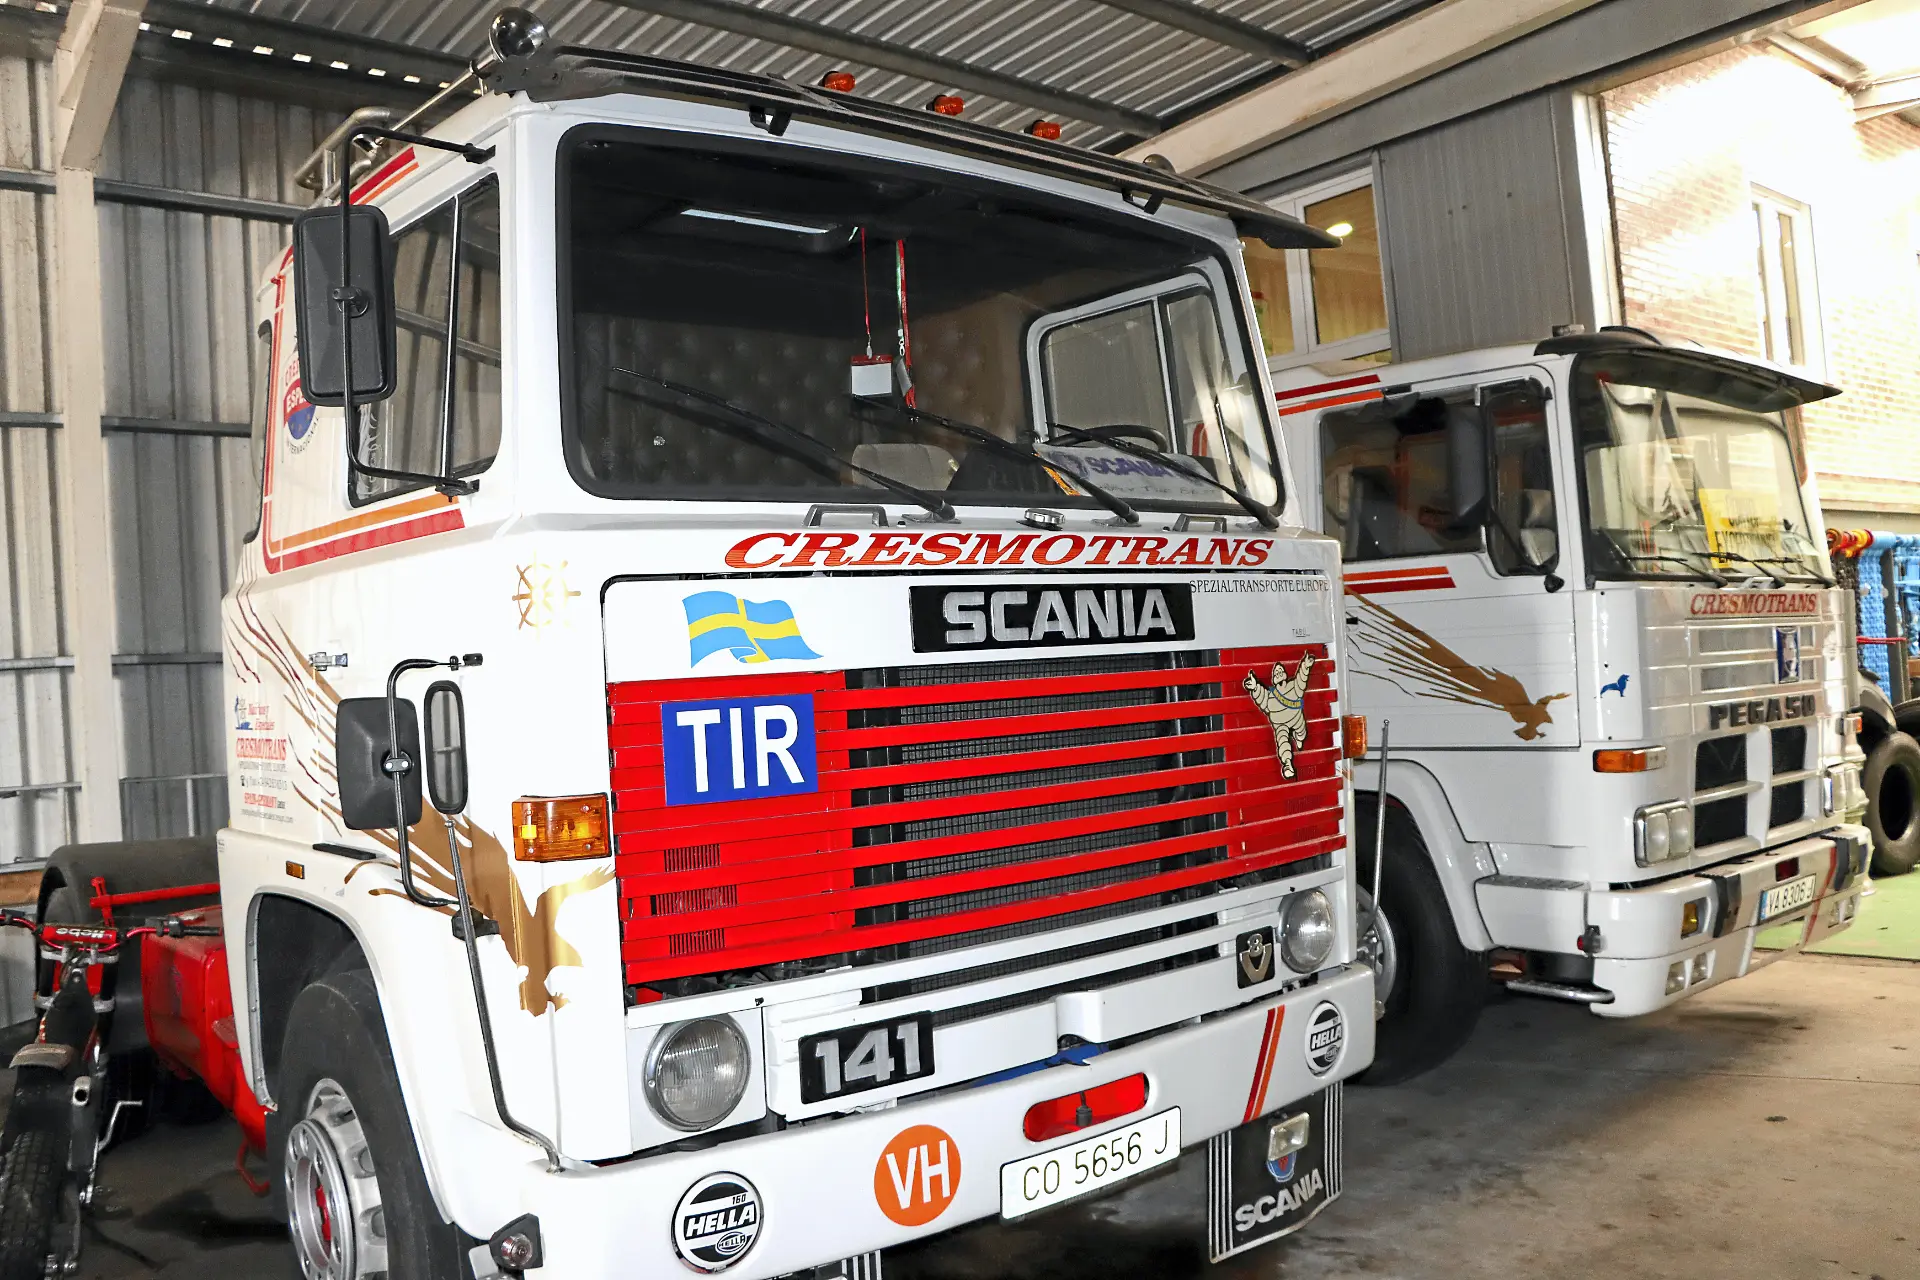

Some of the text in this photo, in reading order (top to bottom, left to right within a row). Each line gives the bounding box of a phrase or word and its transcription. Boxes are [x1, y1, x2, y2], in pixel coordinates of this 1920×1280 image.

[724, 532, 1275, 569] CRESMOTRANS
[1189, 579, 1330, 594] SPEZIALTRANSPORTE EUROPE
[1689, 592, 1818, 616] CRESMOTRANS
[944, 588, 1177, 645] SCANIA
[1708, 694, 1817, 731] PEGASO
[236, 737, 288, 761] CRESMOTRANS
[676, 704, 805, 793] TIR
[1769, 879, 1814, 913] VA 8306 J
[1310, 1025, 1342, 1050] HELLA
[815, 1021, 921, 1094] 141
[886, 1139, 952, 1210] VH
[1022, 1119, 1169, 1201] CO 5656 J
[732, 1193, 747, 1206] 160
[1234, 1168, 1325, 1232] SCANIA
[685, 1203, 755, 1238] HELLA
[718, 1235, 746, 1248] HELLA
